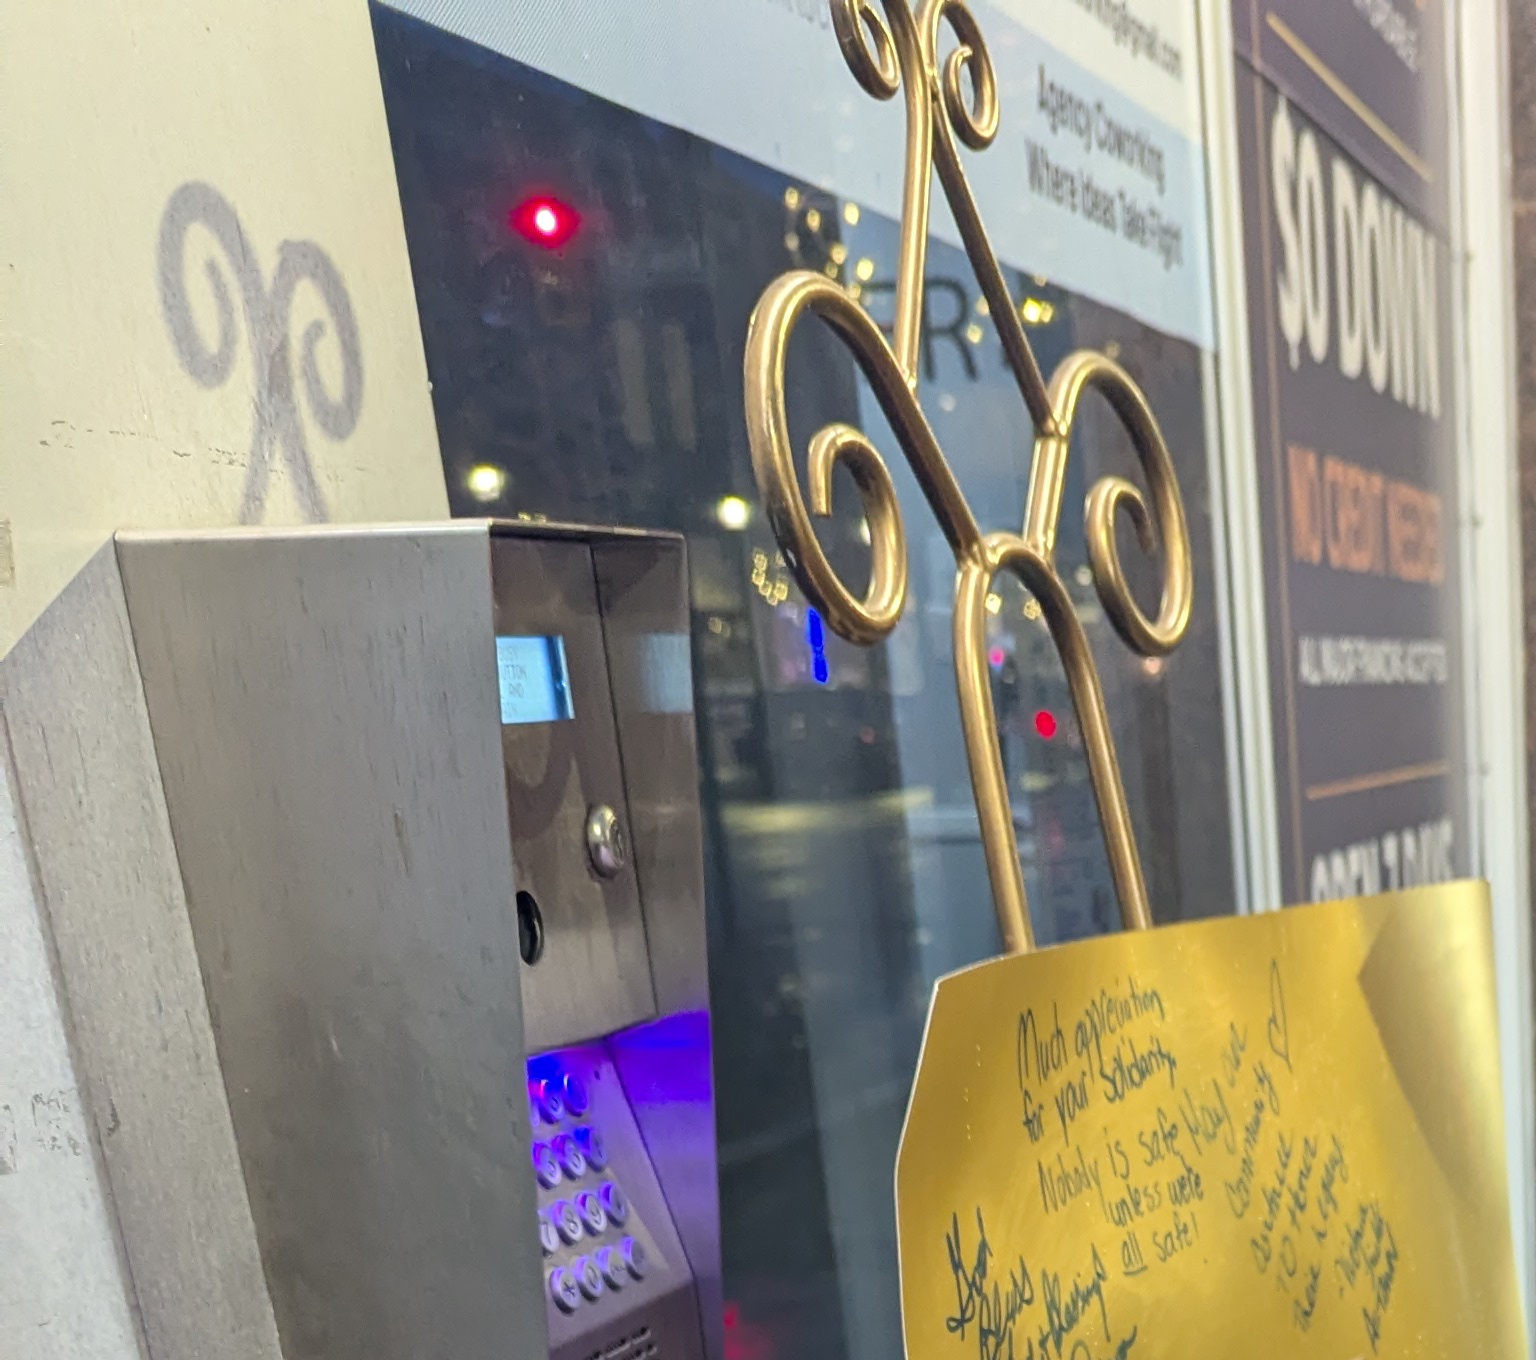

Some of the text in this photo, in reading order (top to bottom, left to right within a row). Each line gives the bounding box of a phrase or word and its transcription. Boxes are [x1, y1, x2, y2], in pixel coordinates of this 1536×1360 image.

[1037, 62, 1093, 155] Agency
[1024, 136, 1077, 214] Where
[1332, 155, 1441, 422] DOWN
[1018, 1001, 1069, 1090] Much
[1022, 1088, 1046, 1145] for
[1054, 1070, 1090, 1148] your
[1037, 1107, 1181, 1225] Nobody is safe
[1107, 1183, 1161, 1228] unless
[1121, 1231, 1149, 1276] all
